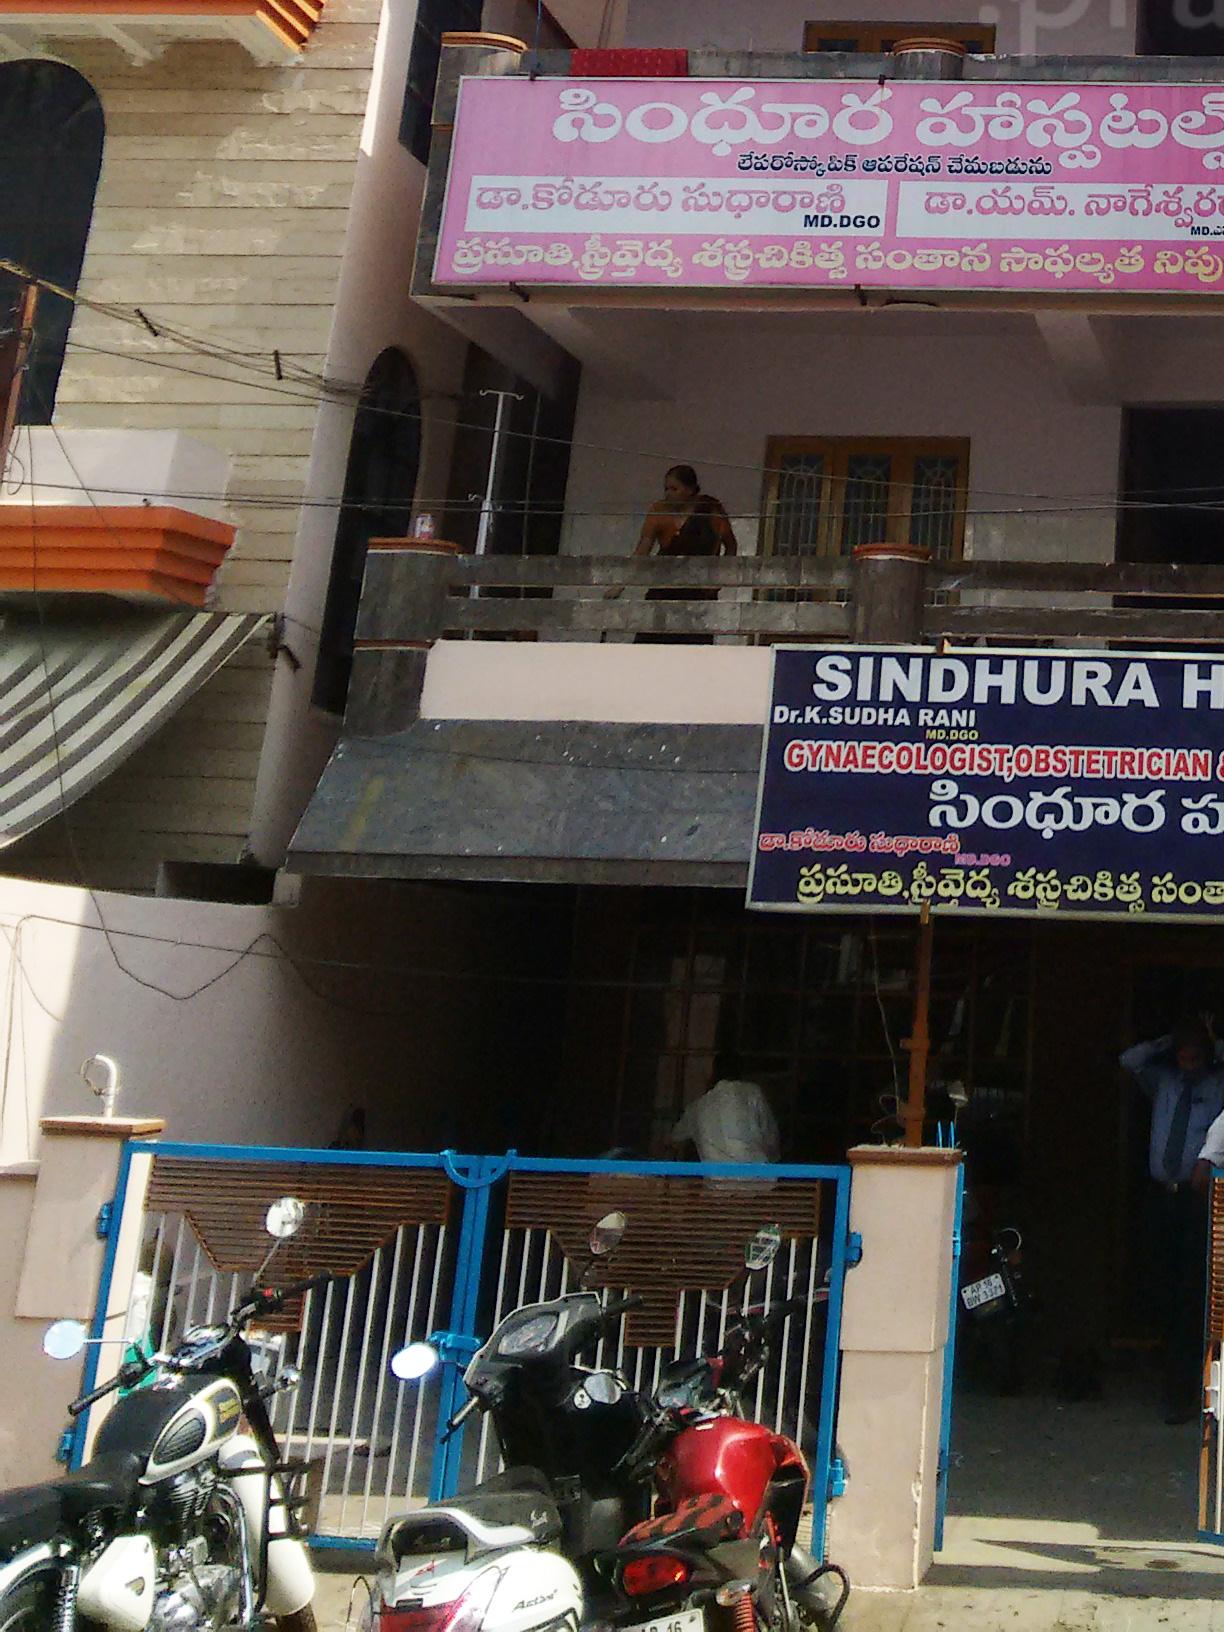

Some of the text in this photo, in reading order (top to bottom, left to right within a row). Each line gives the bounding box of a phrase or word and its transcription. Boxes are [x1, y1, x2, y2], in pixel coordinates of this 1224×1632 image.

[552, 87, 893, 156] సింధూర
[681, 182, 847, 219] సుధారాణి
[803, 214, 881, 229] MD.DGO
[854, 240, 992, 272] సంతాన
[1000, 244, 1146, 284] సాఫల్యత
[812, 654, 1161, 709] SINDHURA
[772, 705, 977, 728] Dr.K.SUDHA RANI
[925, 729, 979, 741] MD.DGO
[928, 779, 1167, 839] సింధూర
